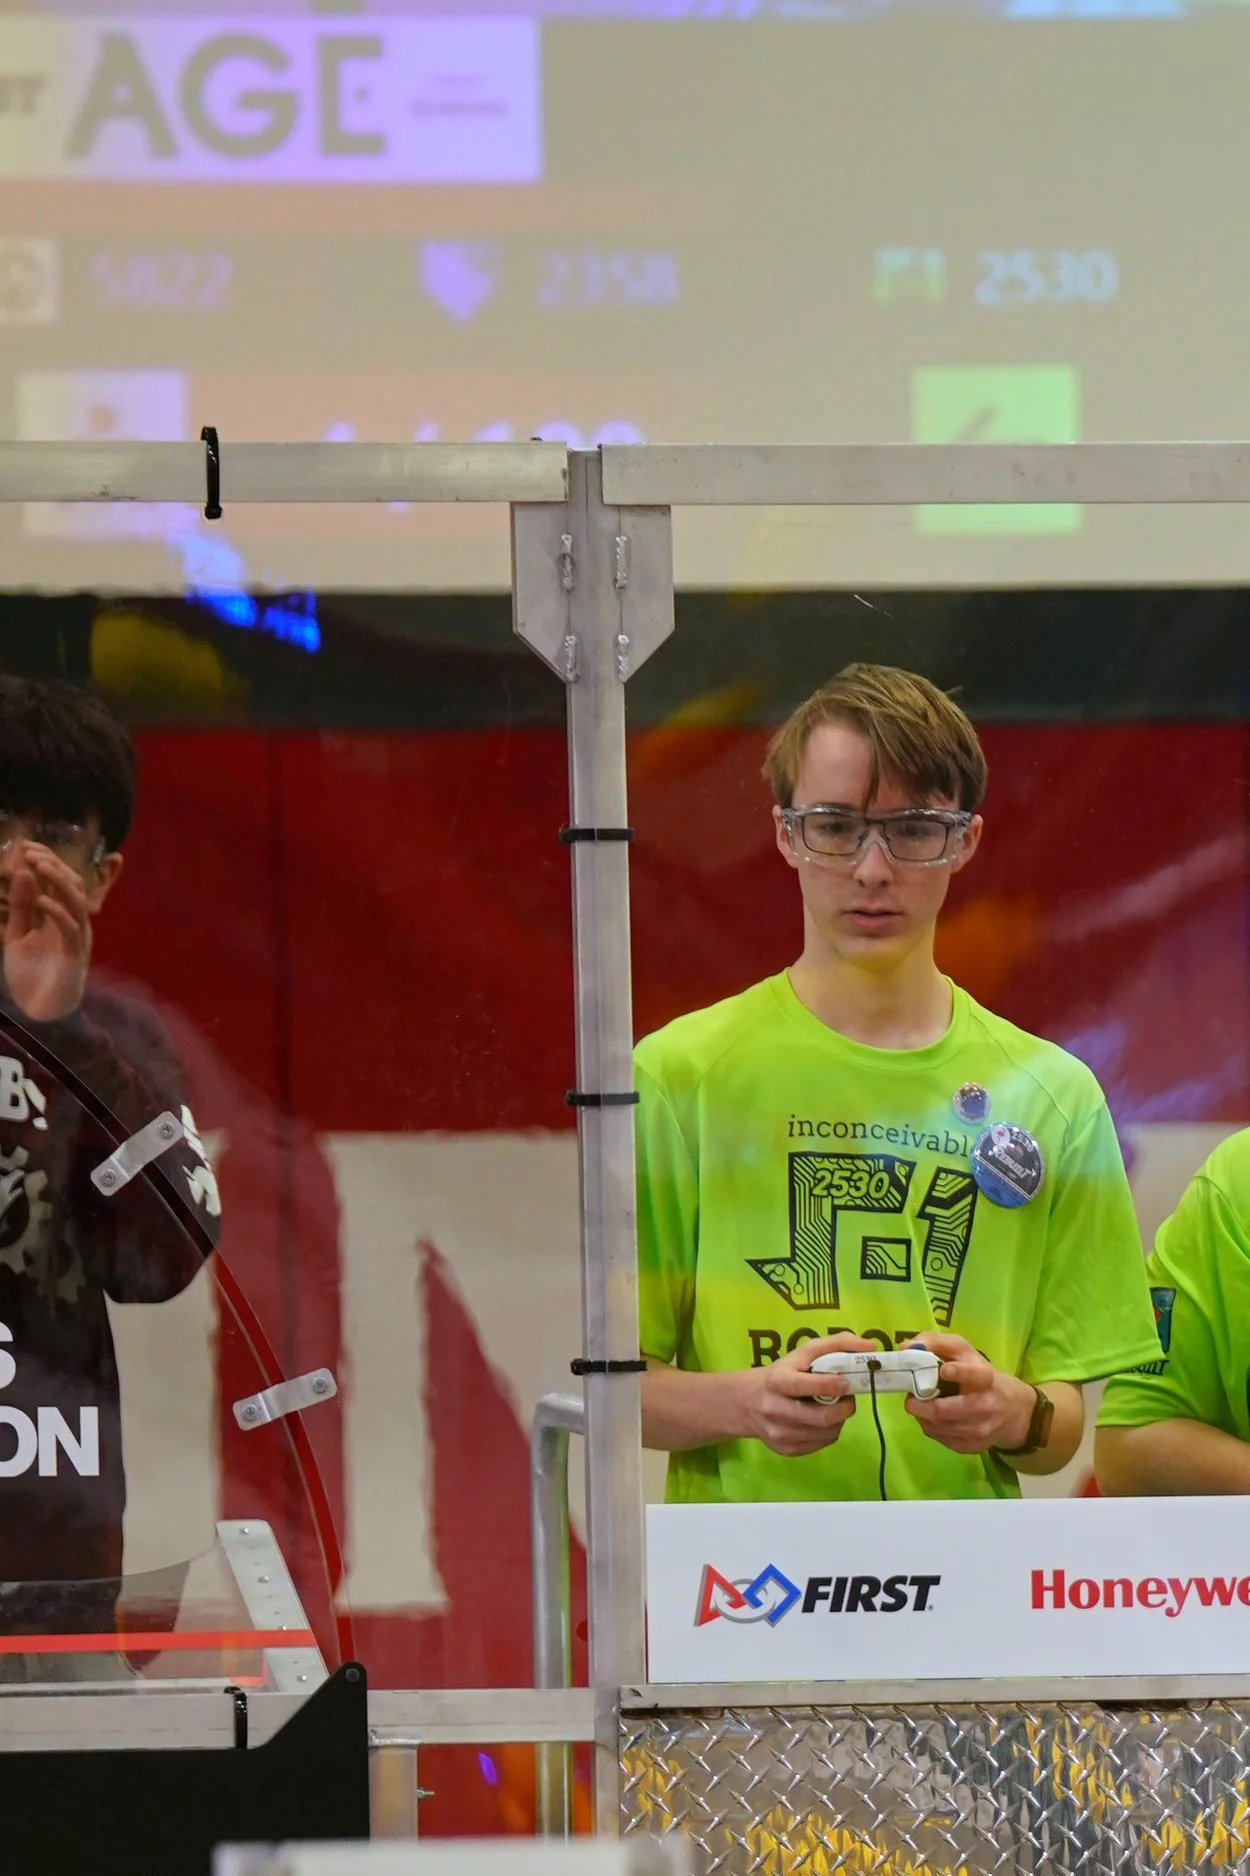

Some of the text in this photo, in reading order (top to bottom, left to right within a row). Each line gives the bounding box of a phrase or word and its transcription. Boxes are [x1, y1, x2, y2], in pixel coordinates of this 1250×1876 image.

[66, 33, 387, 159] AGE
[973, 248, 1120, 306] 2530
[788, 1113, 970, 1157] inconceivabl
[811, 1168, 890, 1199] 2530
[802, 1575, 941, 1613] FIRST
